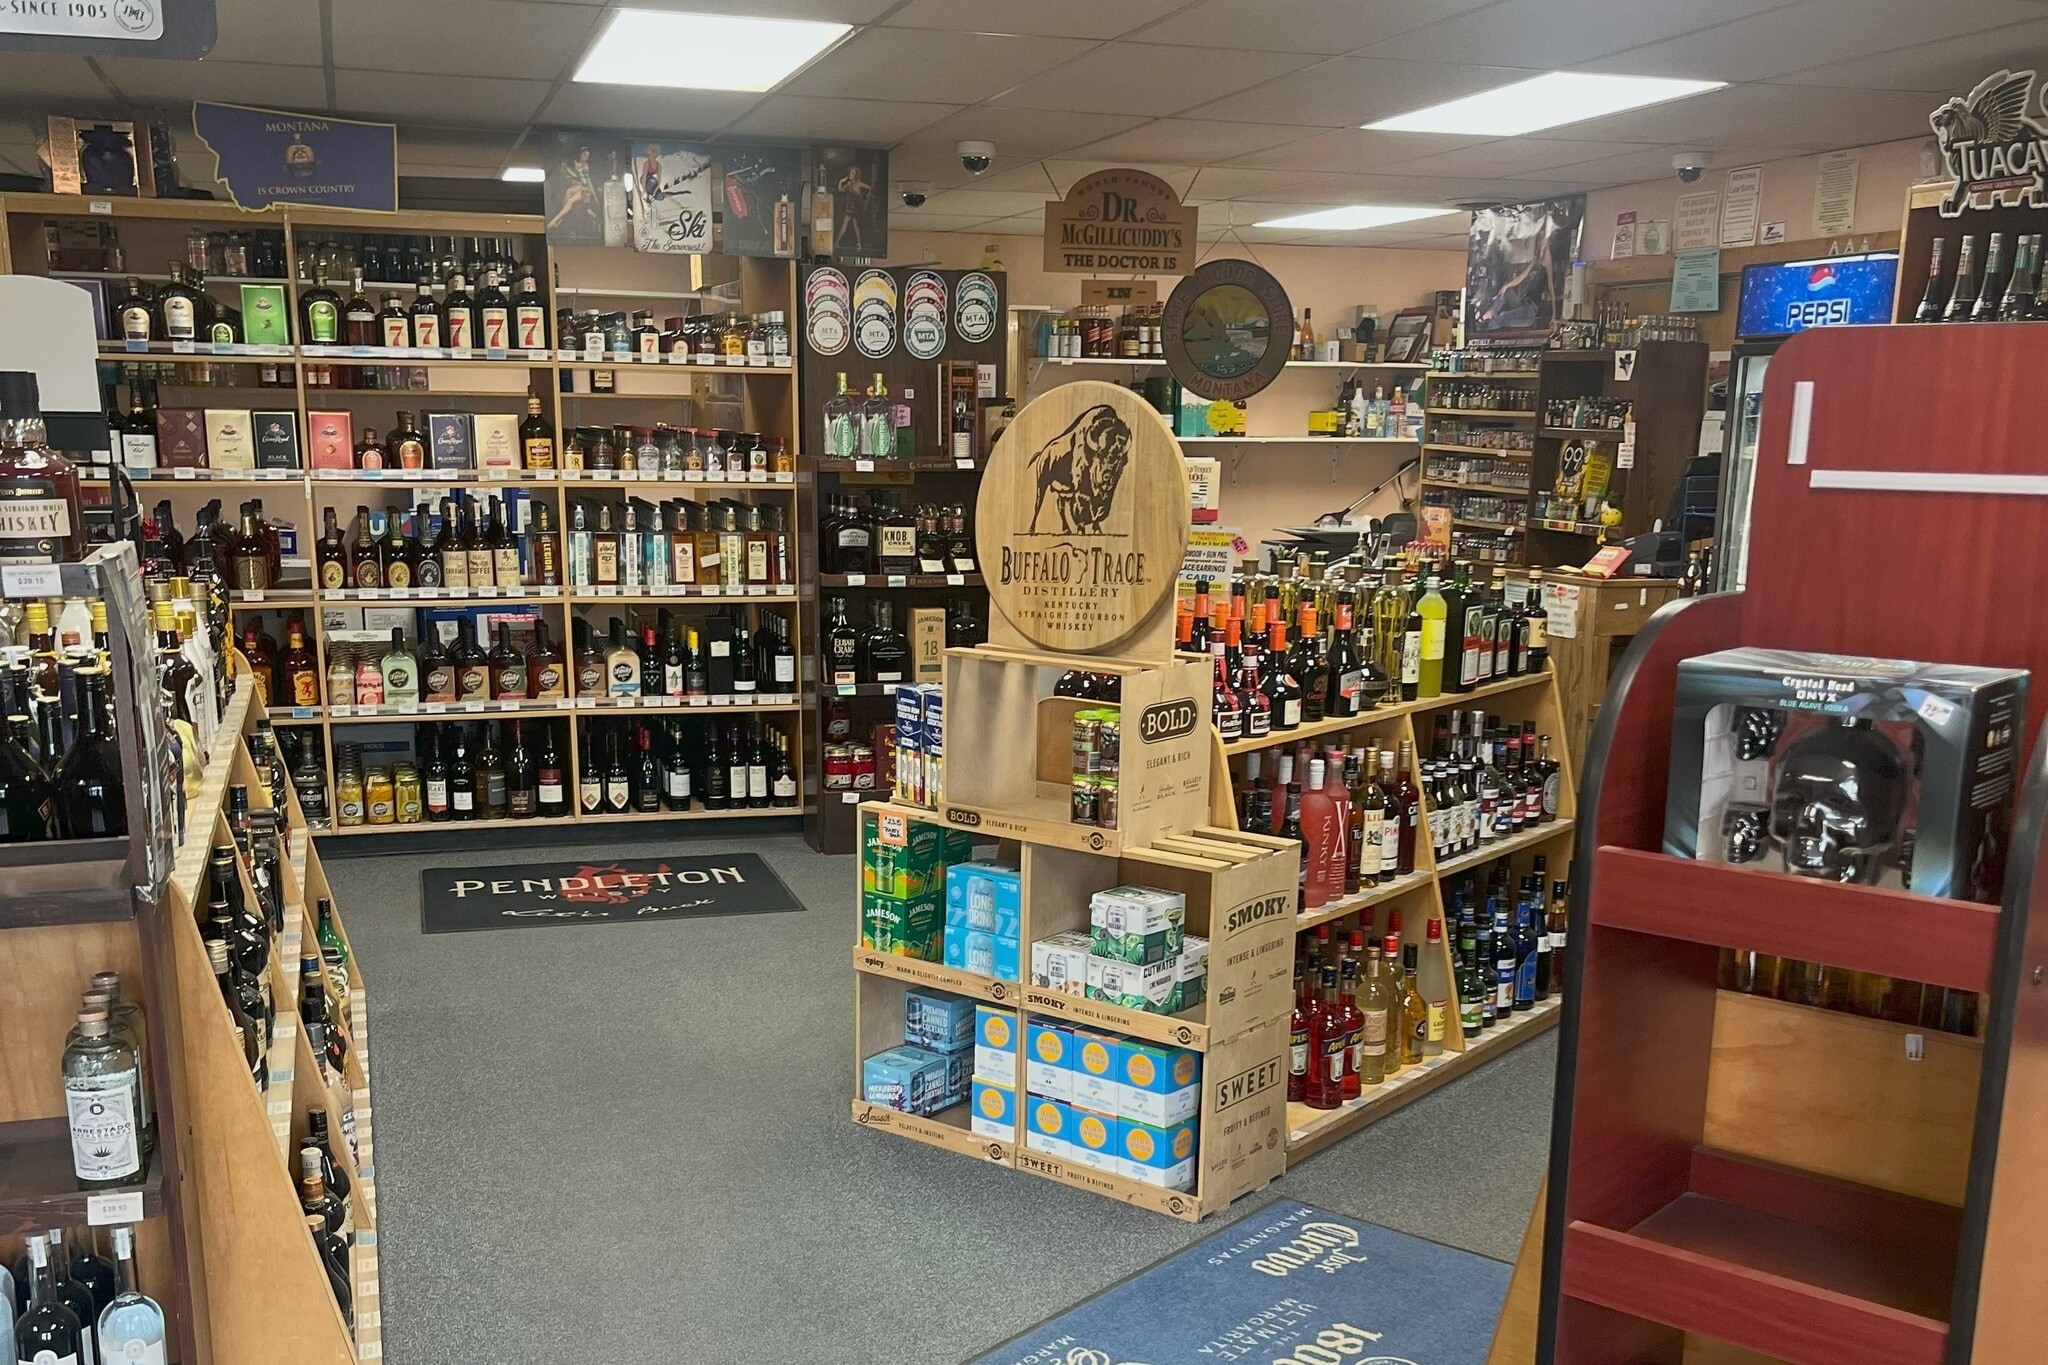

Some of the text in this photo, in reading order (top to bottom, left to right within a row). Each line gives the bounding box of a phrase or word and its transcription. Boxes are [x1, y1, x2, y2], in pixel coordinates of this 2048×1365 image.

[11, 1, 59, 15] SINCE
[68, 3, 106, 19] 1905
[265, 121, 329, 133] MONTANA
[257, 184, 356, 196] IS CROWN COUNTRY
[1101, 191, 1144, 223] DR.
[669, 210, 706, 241] Ski
[1064, 254, 1176, 269] THE DOCTOR IS
[966, 314, 984, 323] MTA
[1787, 299, 1850, 326] PEPSI
[389, 326, 402, 346] 7
[420, 322, 434, 344] 7
[450, 318, 465, 347] 7
[486, 319, 505, 347] 7
[521, 317, 539, 345] 7
[822, 327, 838, 335] MTA
[645, 338, 655, 352] 7
[1189, 371, 1267, 397] MONTANA
[1564, 447, 1583, 470] 99
[884, 530, 907, 541] KNOB
[1000, 545, 1146, 586] BUFFALO TRACE
[1196, 564, 1226, 573] EARRINGS
[1023, 586, 1120, 598] DISTILLERY
[1044, 601, 1099, 610] KENTUCKY
[917, 616, 944, 625] JAMESON
[1018, 610, 1125, 622] STRAIGHT BOURBON
[1047, 622, 1094, 632] WHISKEY
[833, 646, 855, 655] CRAIG
[834, 638, 855, 647] ELIJAH
[924, 641, 938, 656] 18
[1782, 676, 1855, 692] Crystal Head
[1779, 699, 1797, 708] BLUE
[1798, 700, 1822, 710] AGAVE
[1796, 690, 1837, 703] ONYX
[1146, 706, 1191, 736] BOLD
[1146, 751, 1171, 769] ELEGANT
[1178, 750, 1191, 761] RICH
[950, 810, 978, 825] BOLD
[986, 820, 1008, 830] ELEGANT
[1014, 824, 1027, 833] RICH
[912, 831, 938, 847] JAMESON
[448, 866, 746, 899] PENDLETON
[970, 894, 993, 910] LONG
[866, 909, 902, 925] JAMESON
[908, 903, 936, 918] JAMESON
[969, 910, 993, 926] DRINK
[1228, 896, 1287, 932] SMOKY
[969, 948, 993, 965] LONG
[1226, 951, 1250, 967] INTENSE
[1256, 937, 1284, 956] LINGERING
[865, 957, 885, 970] spicy
[1143, 957, 1177, 979] CUTWATER
[897, 966, 911, 974] WARM
[917, 969, 940, 981] SLIGHTLY
[940, 975, 962, 987] COMPLEX
[1027, 994, 1066, 1010] SMOKY
[922, 1003, 949, 1019] PREMIUM
[1073, 1007, 1096, 1018] INTENSE
[1101, 1013, 1130, 1026] LINGERING
[922, 1012, 949, 1027] CANNED
[922, 1021, 949, 1036] COCKTAILS
[925, 1078, 945, 1091] CANNED
[1220, 1061, 1277, 1107] SWEET
[869, 1091, 900, 1101] LEMONADE
[860, 1106, 891, 1124] Smooth
[1223, 1117, 1243, 1136] FRUITY
[1248, 1105, 1271, 1126] REFINED
[72, 1122, 131, 1134] ARRESTADO
[924, 1127, 945, 1140] INVITING
[1024, 1157, 1060, 1174] SWEET
[1067, 1171, 1086, 1183] FRUITY
[1092, 1177, 1114, 1191] REFINED
[1208, 1207, 1313, 1266] MARGARITAS
[1252, 1222, 1360, 1276] Cuervo
[1314, 1248, 1368, 1274] Jose
[1197, 1297, 1297, 1354] MARGARITA
[1216, 1302, 1317, 1362] ULTIMATE
